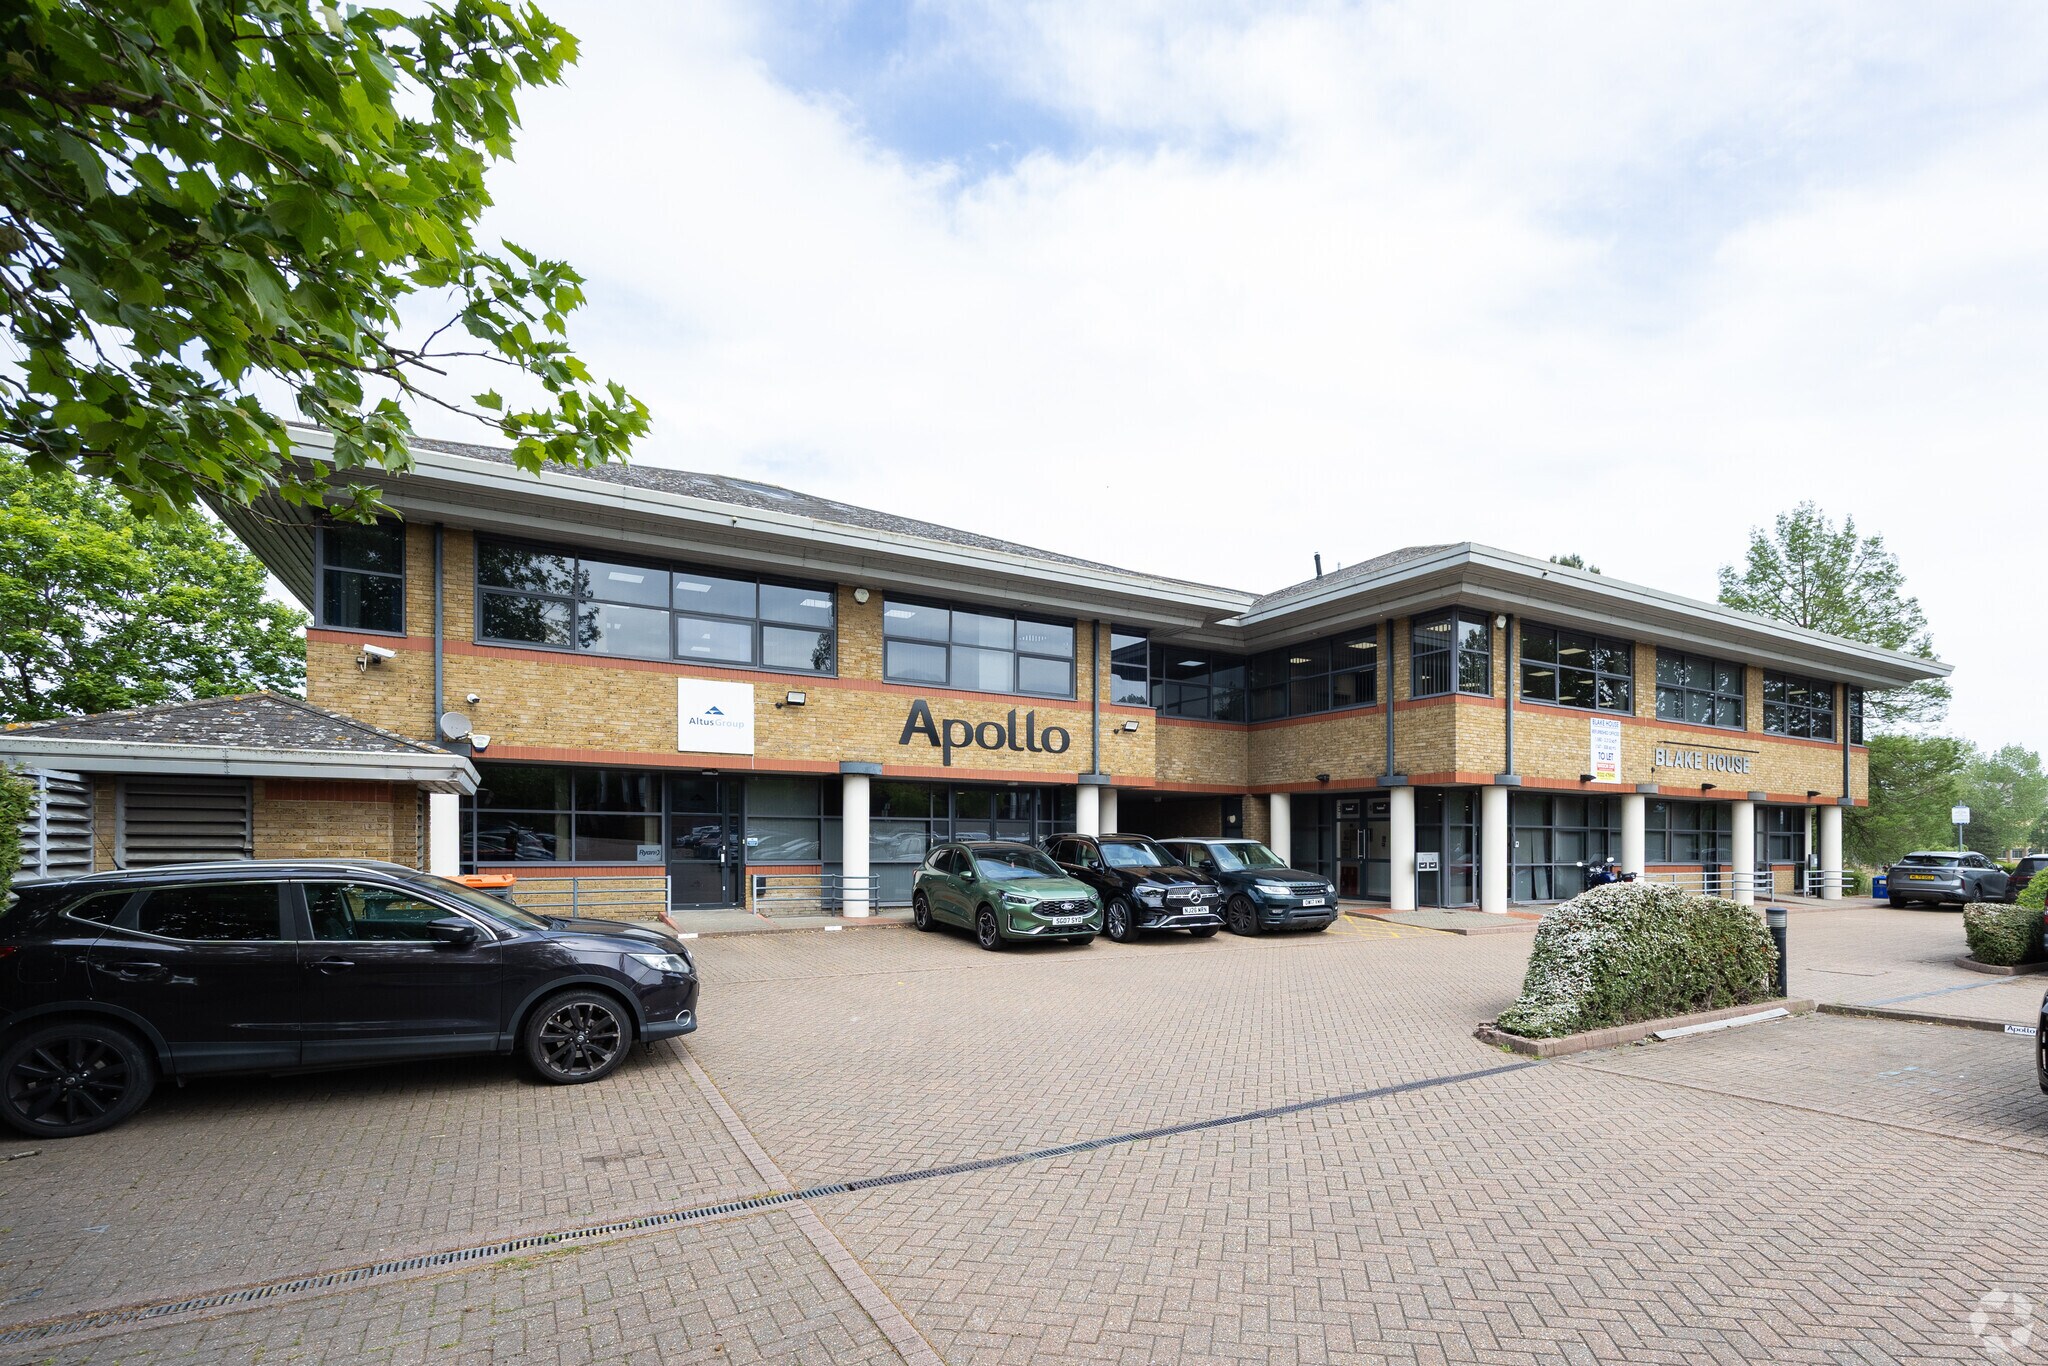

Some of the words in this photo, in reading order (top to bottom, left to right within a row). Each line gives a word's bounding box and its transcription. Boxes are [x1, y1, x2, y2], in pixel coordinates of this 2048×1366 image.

[899, 699, 1070, 766] Apollo
[1598, 752, 1605, 760] TO
[1606, 752, 1614, 761] LET
[1655, 748, 1703, 770] BLAKE
[1707, 752, 1751, 774] HOUSE
[2007, 1025, 2036, 1034] Apollo
